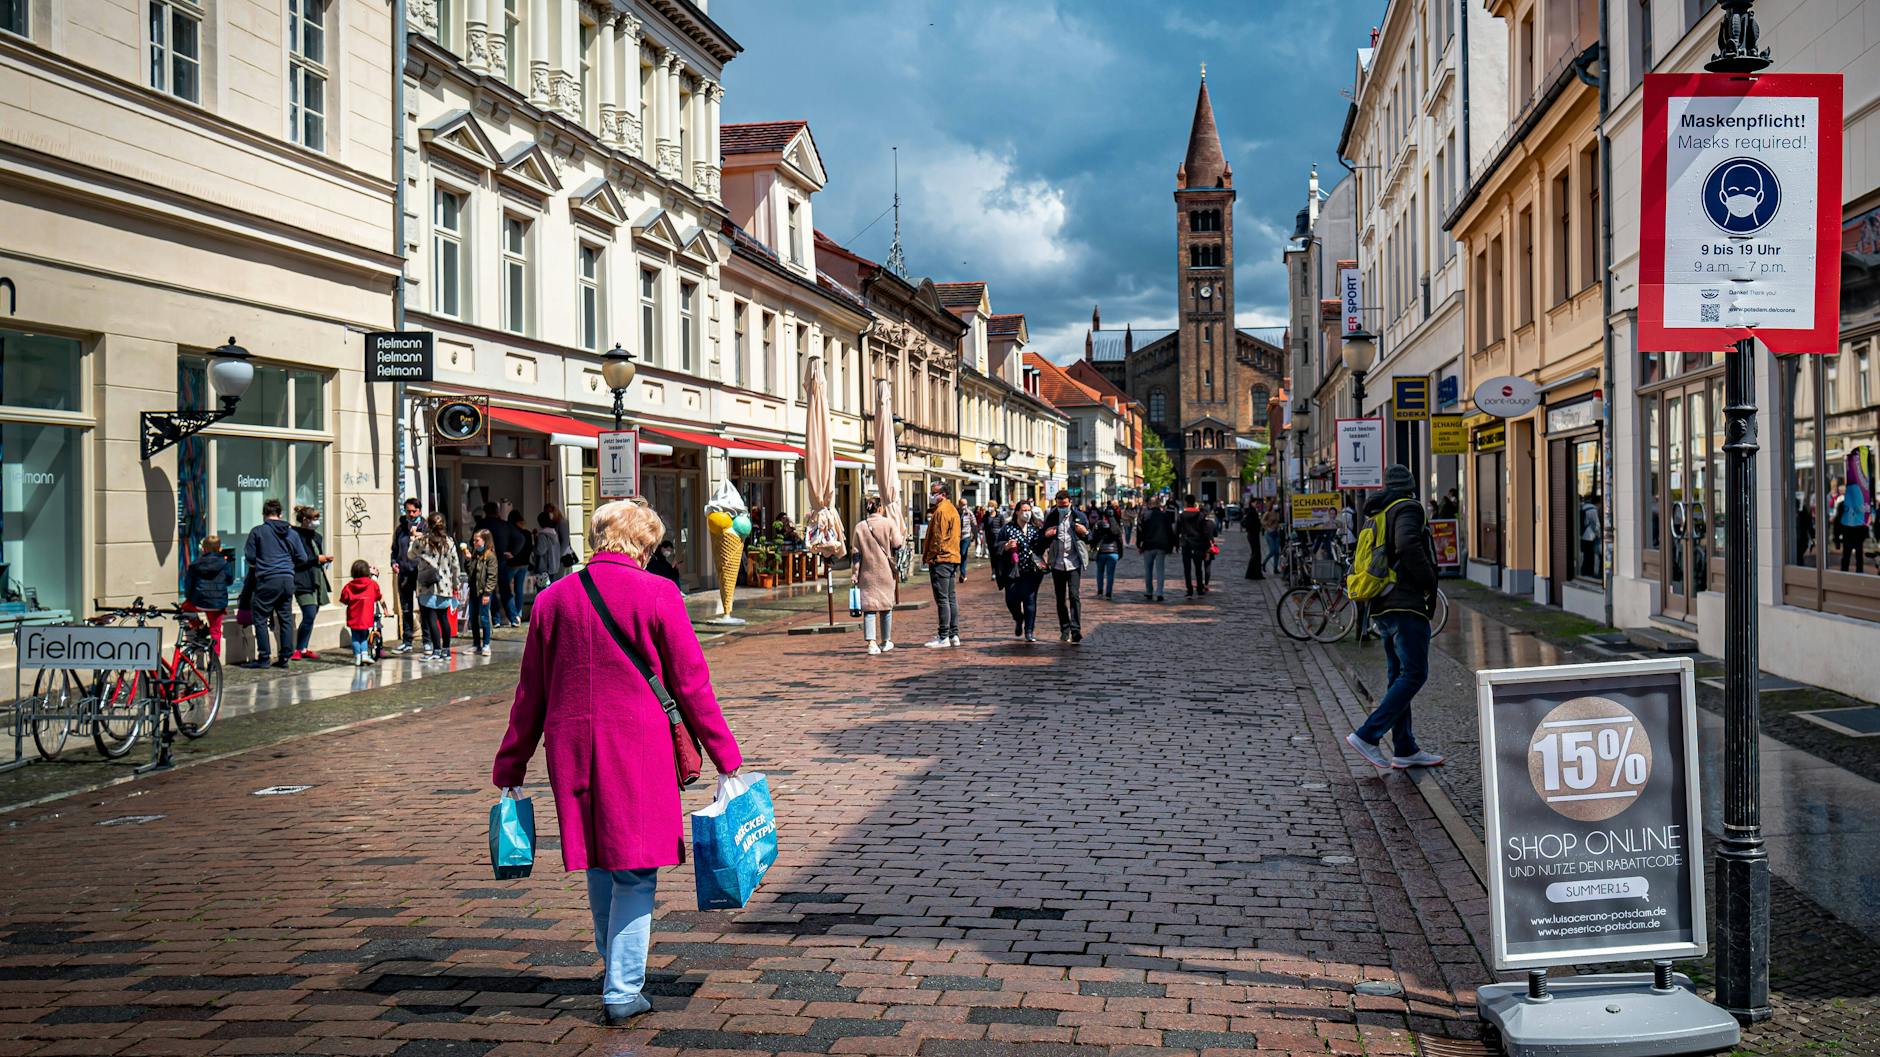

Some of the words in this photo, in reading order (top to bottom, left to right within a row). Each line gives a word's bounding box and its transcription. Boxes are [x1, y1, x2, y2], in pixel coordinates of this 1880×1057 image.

[1681, 114, 1806, 131] Maskenpflicht!
[1678, 135, 1730, 149] Masks
[1735, 135, 1807, 152] required!
[1701, 244, 1709, 256] 9
[1713, 244, 1734, 256] bis
[1739, 244, 1753, 256] 19
[1757, 244, 1781, 256] Uhr
[1694, 260, 1702, 273] 9
[1706, 263, 1733, 273] a.m.
[1748, 261, 1757, 272] 7
[1760, 263, 1787, 275] p.m.
[1347, 275, 1358, 314] SPORT
[1728, 305, 1796, 314] www.potsdam.de/corona
[1533, 727, 1646, 790] 15%
[1508, 834, 1577, 861] SHOP
[1585, 825, 1681, 855] ONLINE
[1509, 864, 1536, 878] UND
[1538, 862, 1577, 876] NUTZE
[1579, 859, 1604, 874] DEN
[1606, 854, 1683, 870] RABATTCODE
[1566, 882, 1630, 898] SUMMER15
[1531, 906, 1667, 926] www.luisacerano-potsdam.de
[1538, 919, 1661, 937] www.peserico-potsdam.de
